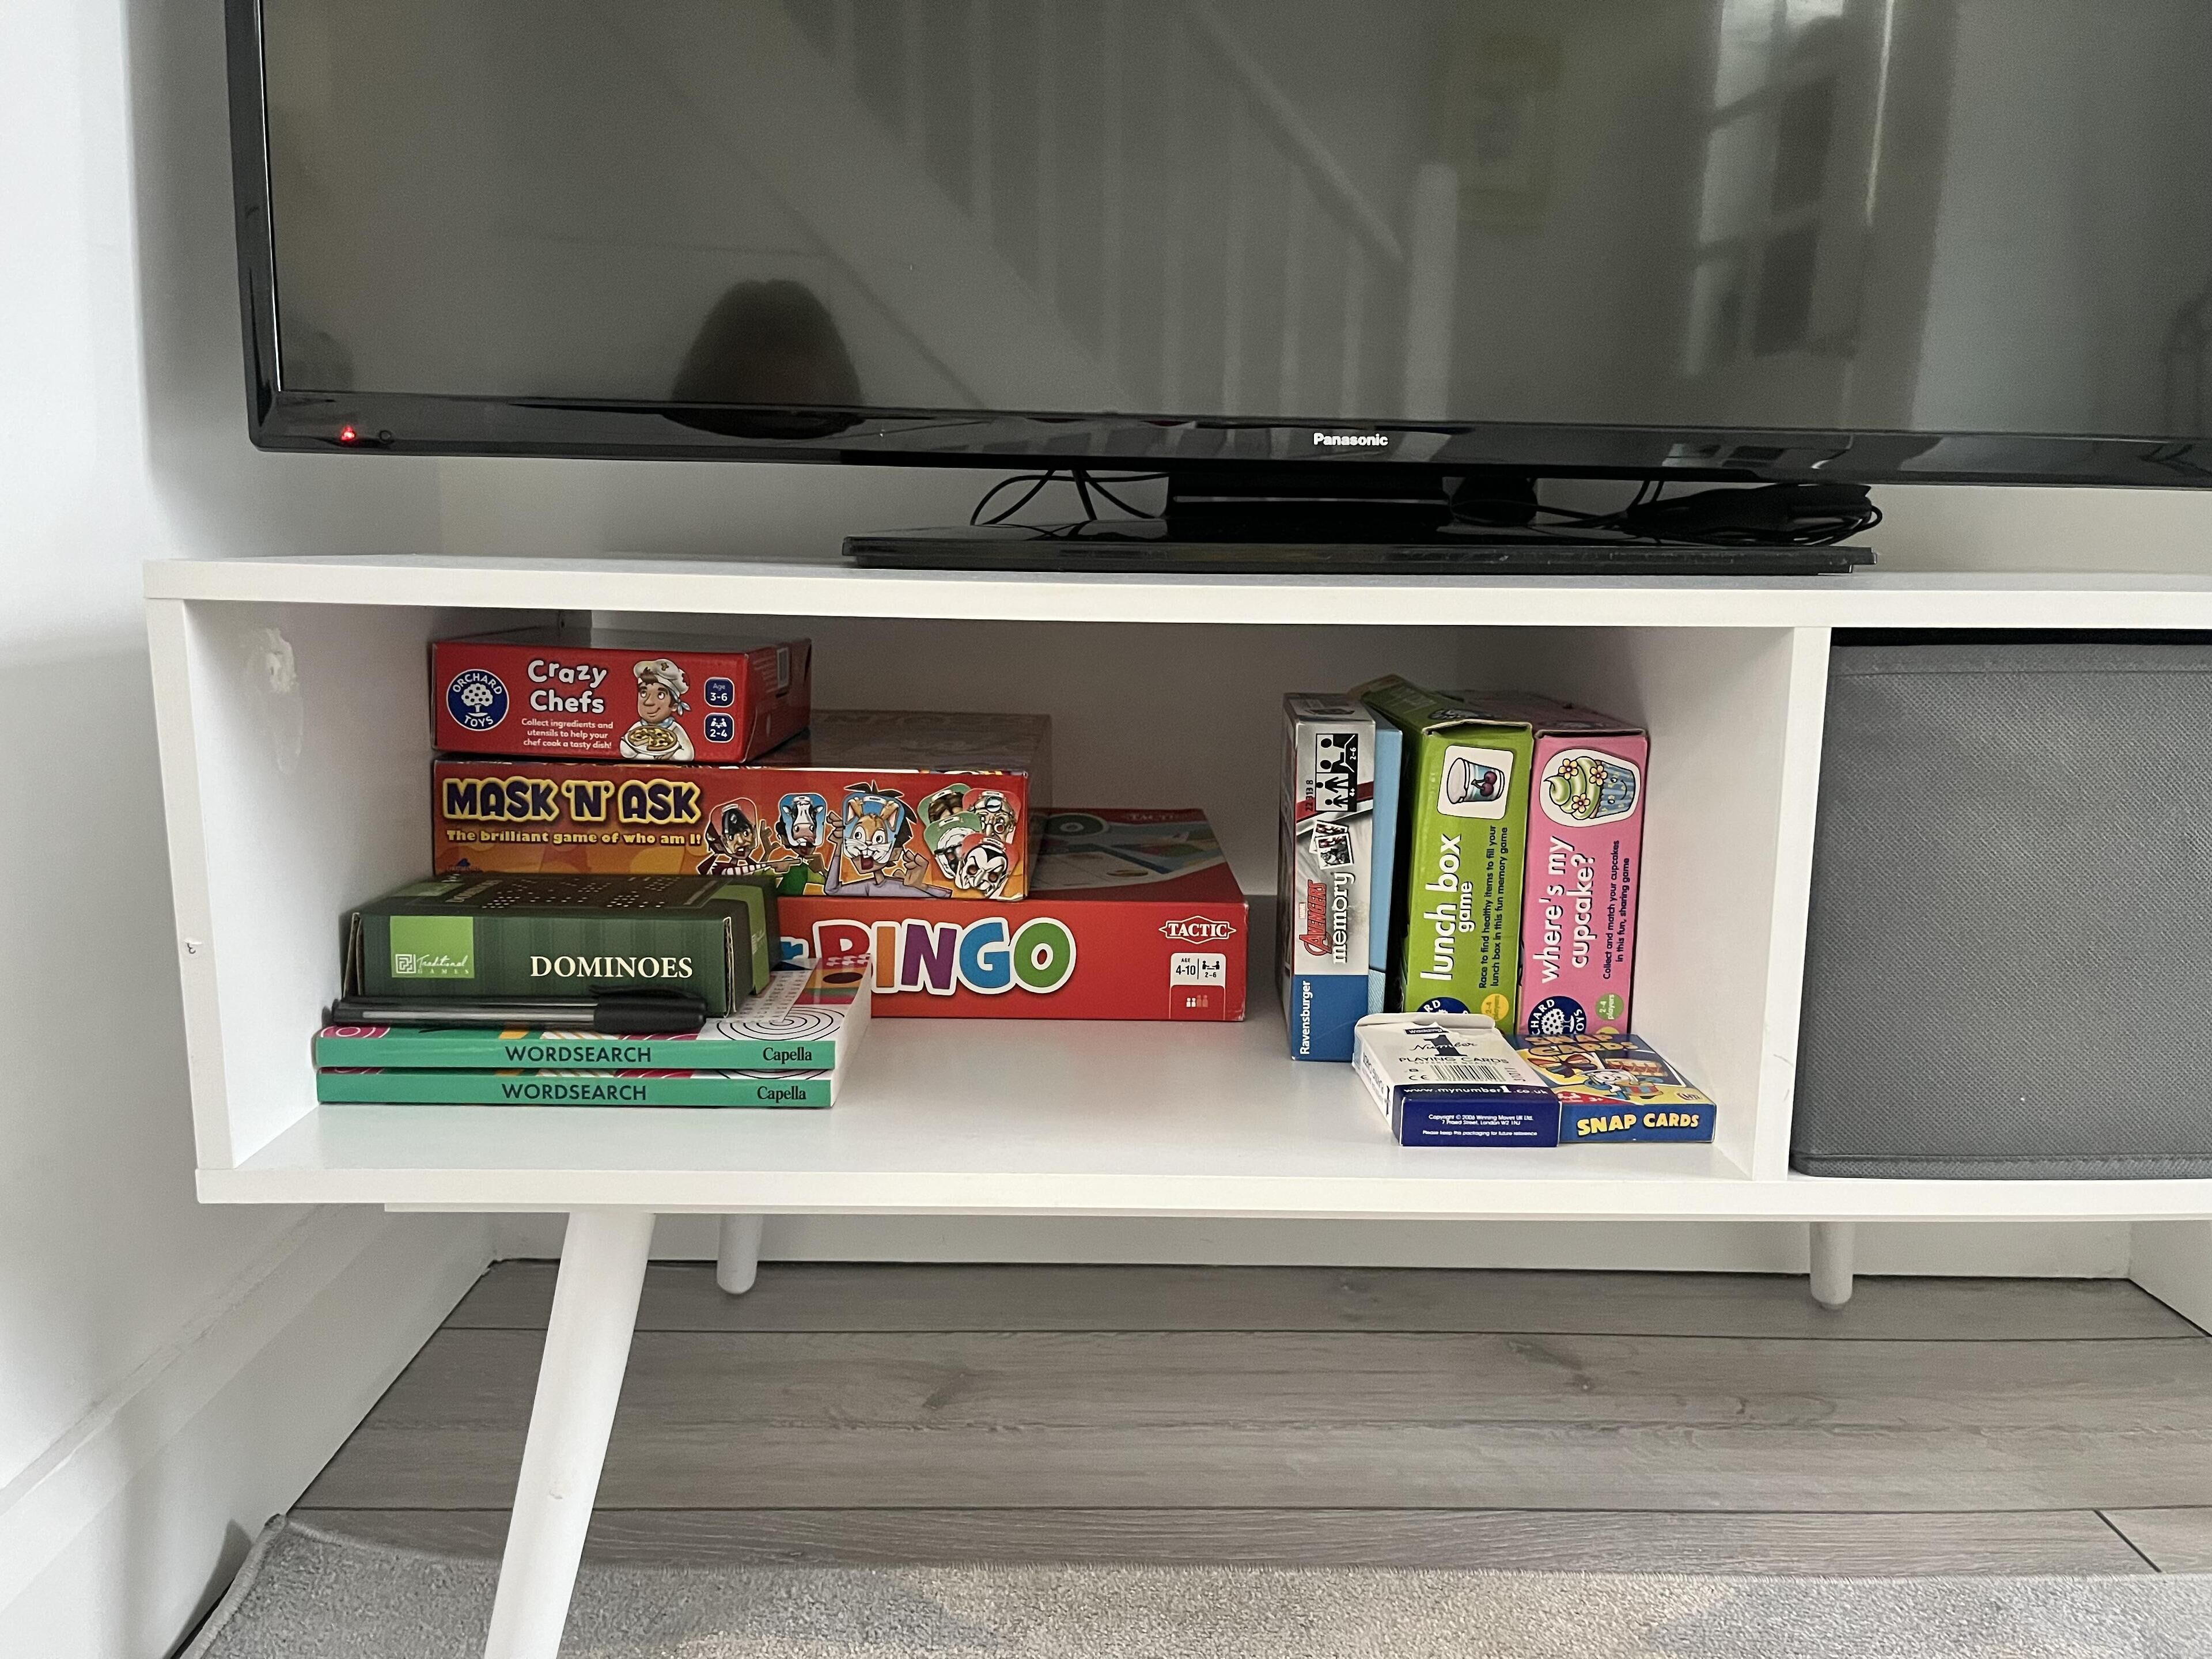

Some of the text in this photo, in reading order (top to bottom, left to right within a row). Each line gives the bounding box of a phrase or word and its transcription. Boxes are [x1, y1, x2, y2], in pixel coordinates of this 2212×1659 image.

[1313, 433, 1388, 446] Panasonic
[452, 672, 502, 695] ORCHARD
[528, 660, 607, 688] Crazy
[530, 690, 604, 713] Chefs
[710, 692, 728, 702] 3-6
[464, 716, 494, 728] TOYS
[521, 718, 548, 726] Collect
[551, 719, 596, 729] ingredients
[710, 729, 728, 737] 2-4
[570, 741, 591, 749] tasty
[571, 730, 588, 738] help
[444, 777, 700, 824] MASK 'N' ASK
[447, 830, 701, 844] The brilliant game of who am I!
[1499, 827, 1508, 854] game
[1425, 833, 1461, 892] box
[1611, 840, 1620, 880] cupcakes
[1498, 857, 1508, 894] memory
[1459, 881, 1475, 932] game
[1479, 825, 1497, 988] Race to find healthy items to fill your
[1495, 897, 1503, 911] fun
[1532, 836, 1574, 983] where's my
[1566, 853, 1597, 968] cupcake?
[1615, 858, 1630, 963] in this fun, sharing game
[1299, 880, 1332, 955] AVENGERS
[1332, 873, 1355, 964] memory
[1494, 914, 1502, 930] this
[1607, 904, 1615, 930] match
[1168, 922, 1228, 938] TACTIC
[1605, 933, 1613, 949] and
[1420, 903, 1457, 980] lunch
[1492, 942, 1501, 960] box
[416, 954, 469, 968] Traditional
[530, 956, 693, 978] DOMINOES
[1176, 965, 1196, 975] 4-10
[1603, 952, 1612, 979] Collect
[1491, 963, 1500, 986] lunch
[1300, 981, 1313, 1055] Ravensburger
[1531, 999, 1555, 1035] CHARD
[1606, 994, 1615, 1020] players
[1574, 1009, 1584, 1032] OYS
[505, 1046, 652, 1062] WORDSEARCH
[763, 1046, 812, 1065] Capella
[1410, 1042, 1478, 1051] Number
[1423, 1034, 1467, 1056] 1
[1529, 1042, 1639, 1056] CARDS
[501, 1084, 646, 1100] WORDSEARCH
[757, 1086, 806, 1103] Capella
[1403, 1085, 1548, 1094] www.mynumber1.co.uk
[1577, 1113, 1700, 1136] SNAP CARDS
